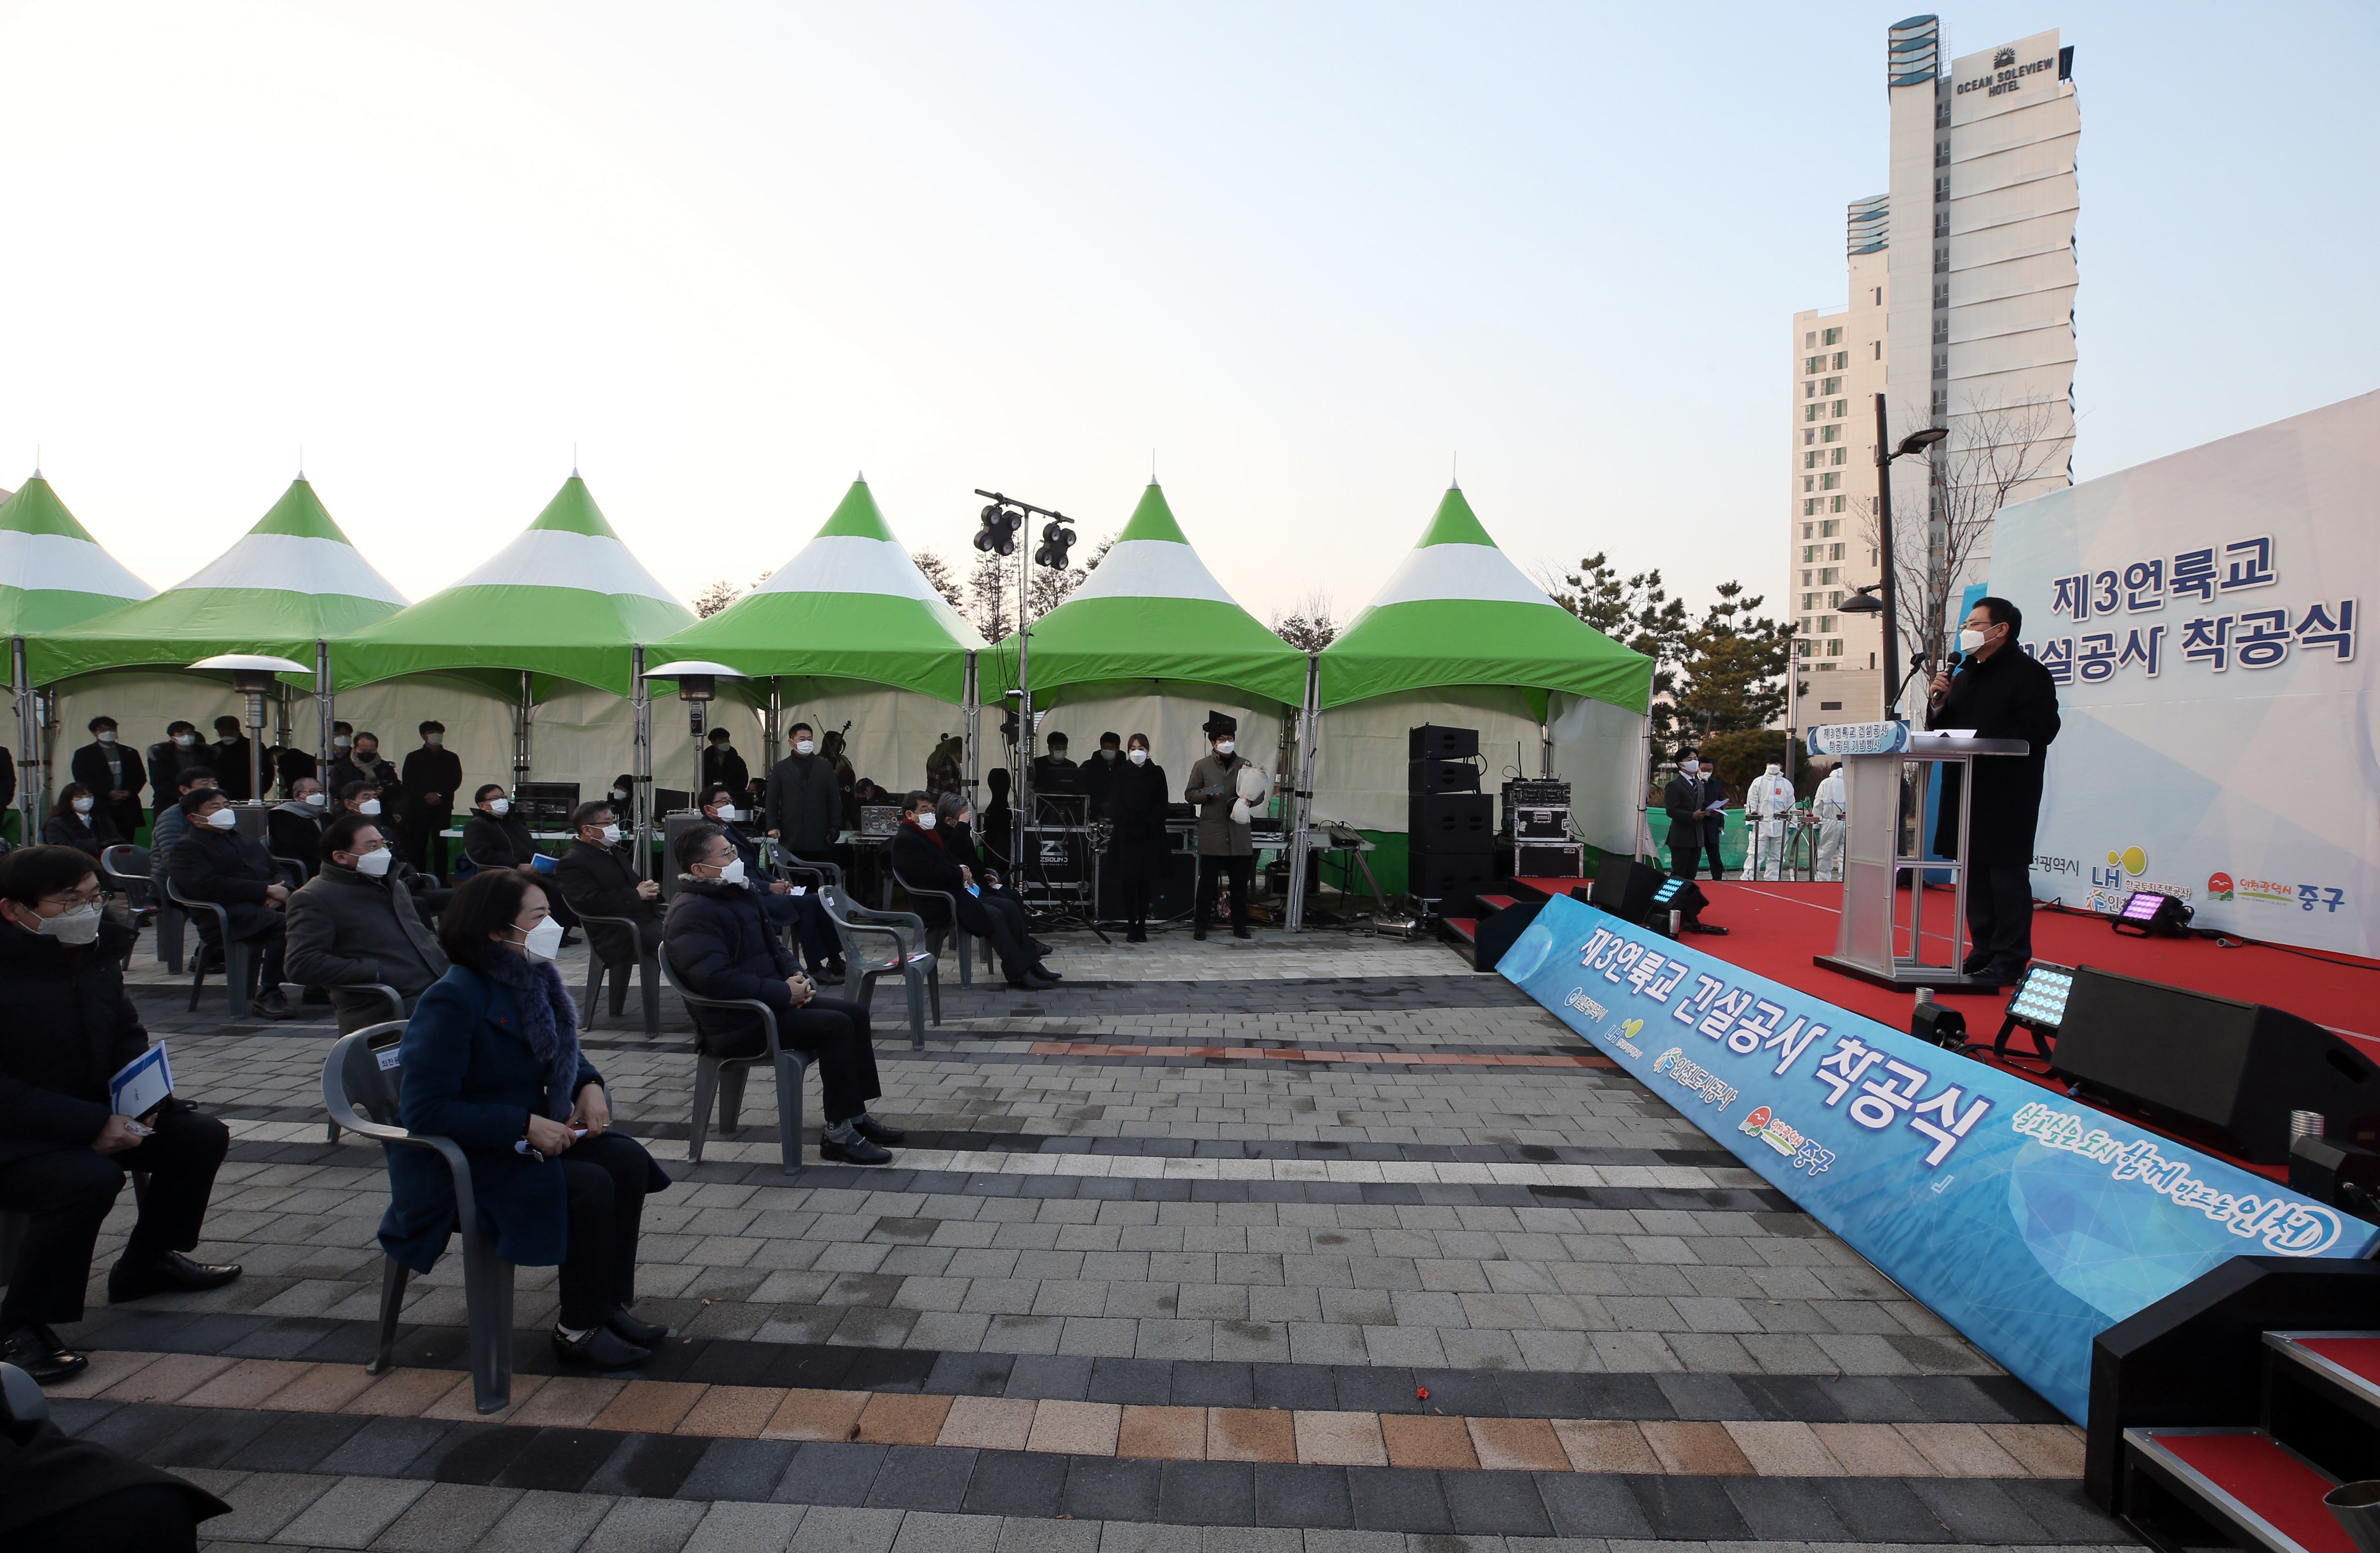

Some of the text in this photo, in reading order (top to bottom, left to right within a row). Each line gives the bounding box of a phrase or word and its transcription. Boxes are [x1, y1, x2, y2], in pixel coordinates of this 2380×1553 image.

[1957, 57, 2053, 94] OCEAN SOLEVIEW
[1989, 79, 2020, 97] HOTEL
[2052, 535, 2276, 621] 제3연륙교
[2181, 597, 2357, 672] 착공식
[1824, 724, 1888, 739] 제3연륙교 건설공사
[1829, 739, 1881, 752] 착공식 기념행사
[2091, 866, 2121, 889] LH
[2125, 879, 2191, 899] 한국토지주택공사
[2240, 878, 2292, 895] 인천광역시
[2297, 884, 2345, 912] 중구
[1574, 994, 1608, 1023] 인천광역시
[1604, 1024, 1624, 1044] LH
[1672, 972, 1831, 1078] 건설공사
[1669, 1057, 1739, 1112] 인천도시공사
[1770, 1118, 1805, 1148] 인천광역시
[1793, 1139, 1836, 1176] 중구
[2075, 1131, 2121, 1162] 도시
[2114, 1142, 2187, 1193] 함께
[2173, 1179, 2232, 1220] 만드는
[2228, 1196, 2340, 1255] 인천
